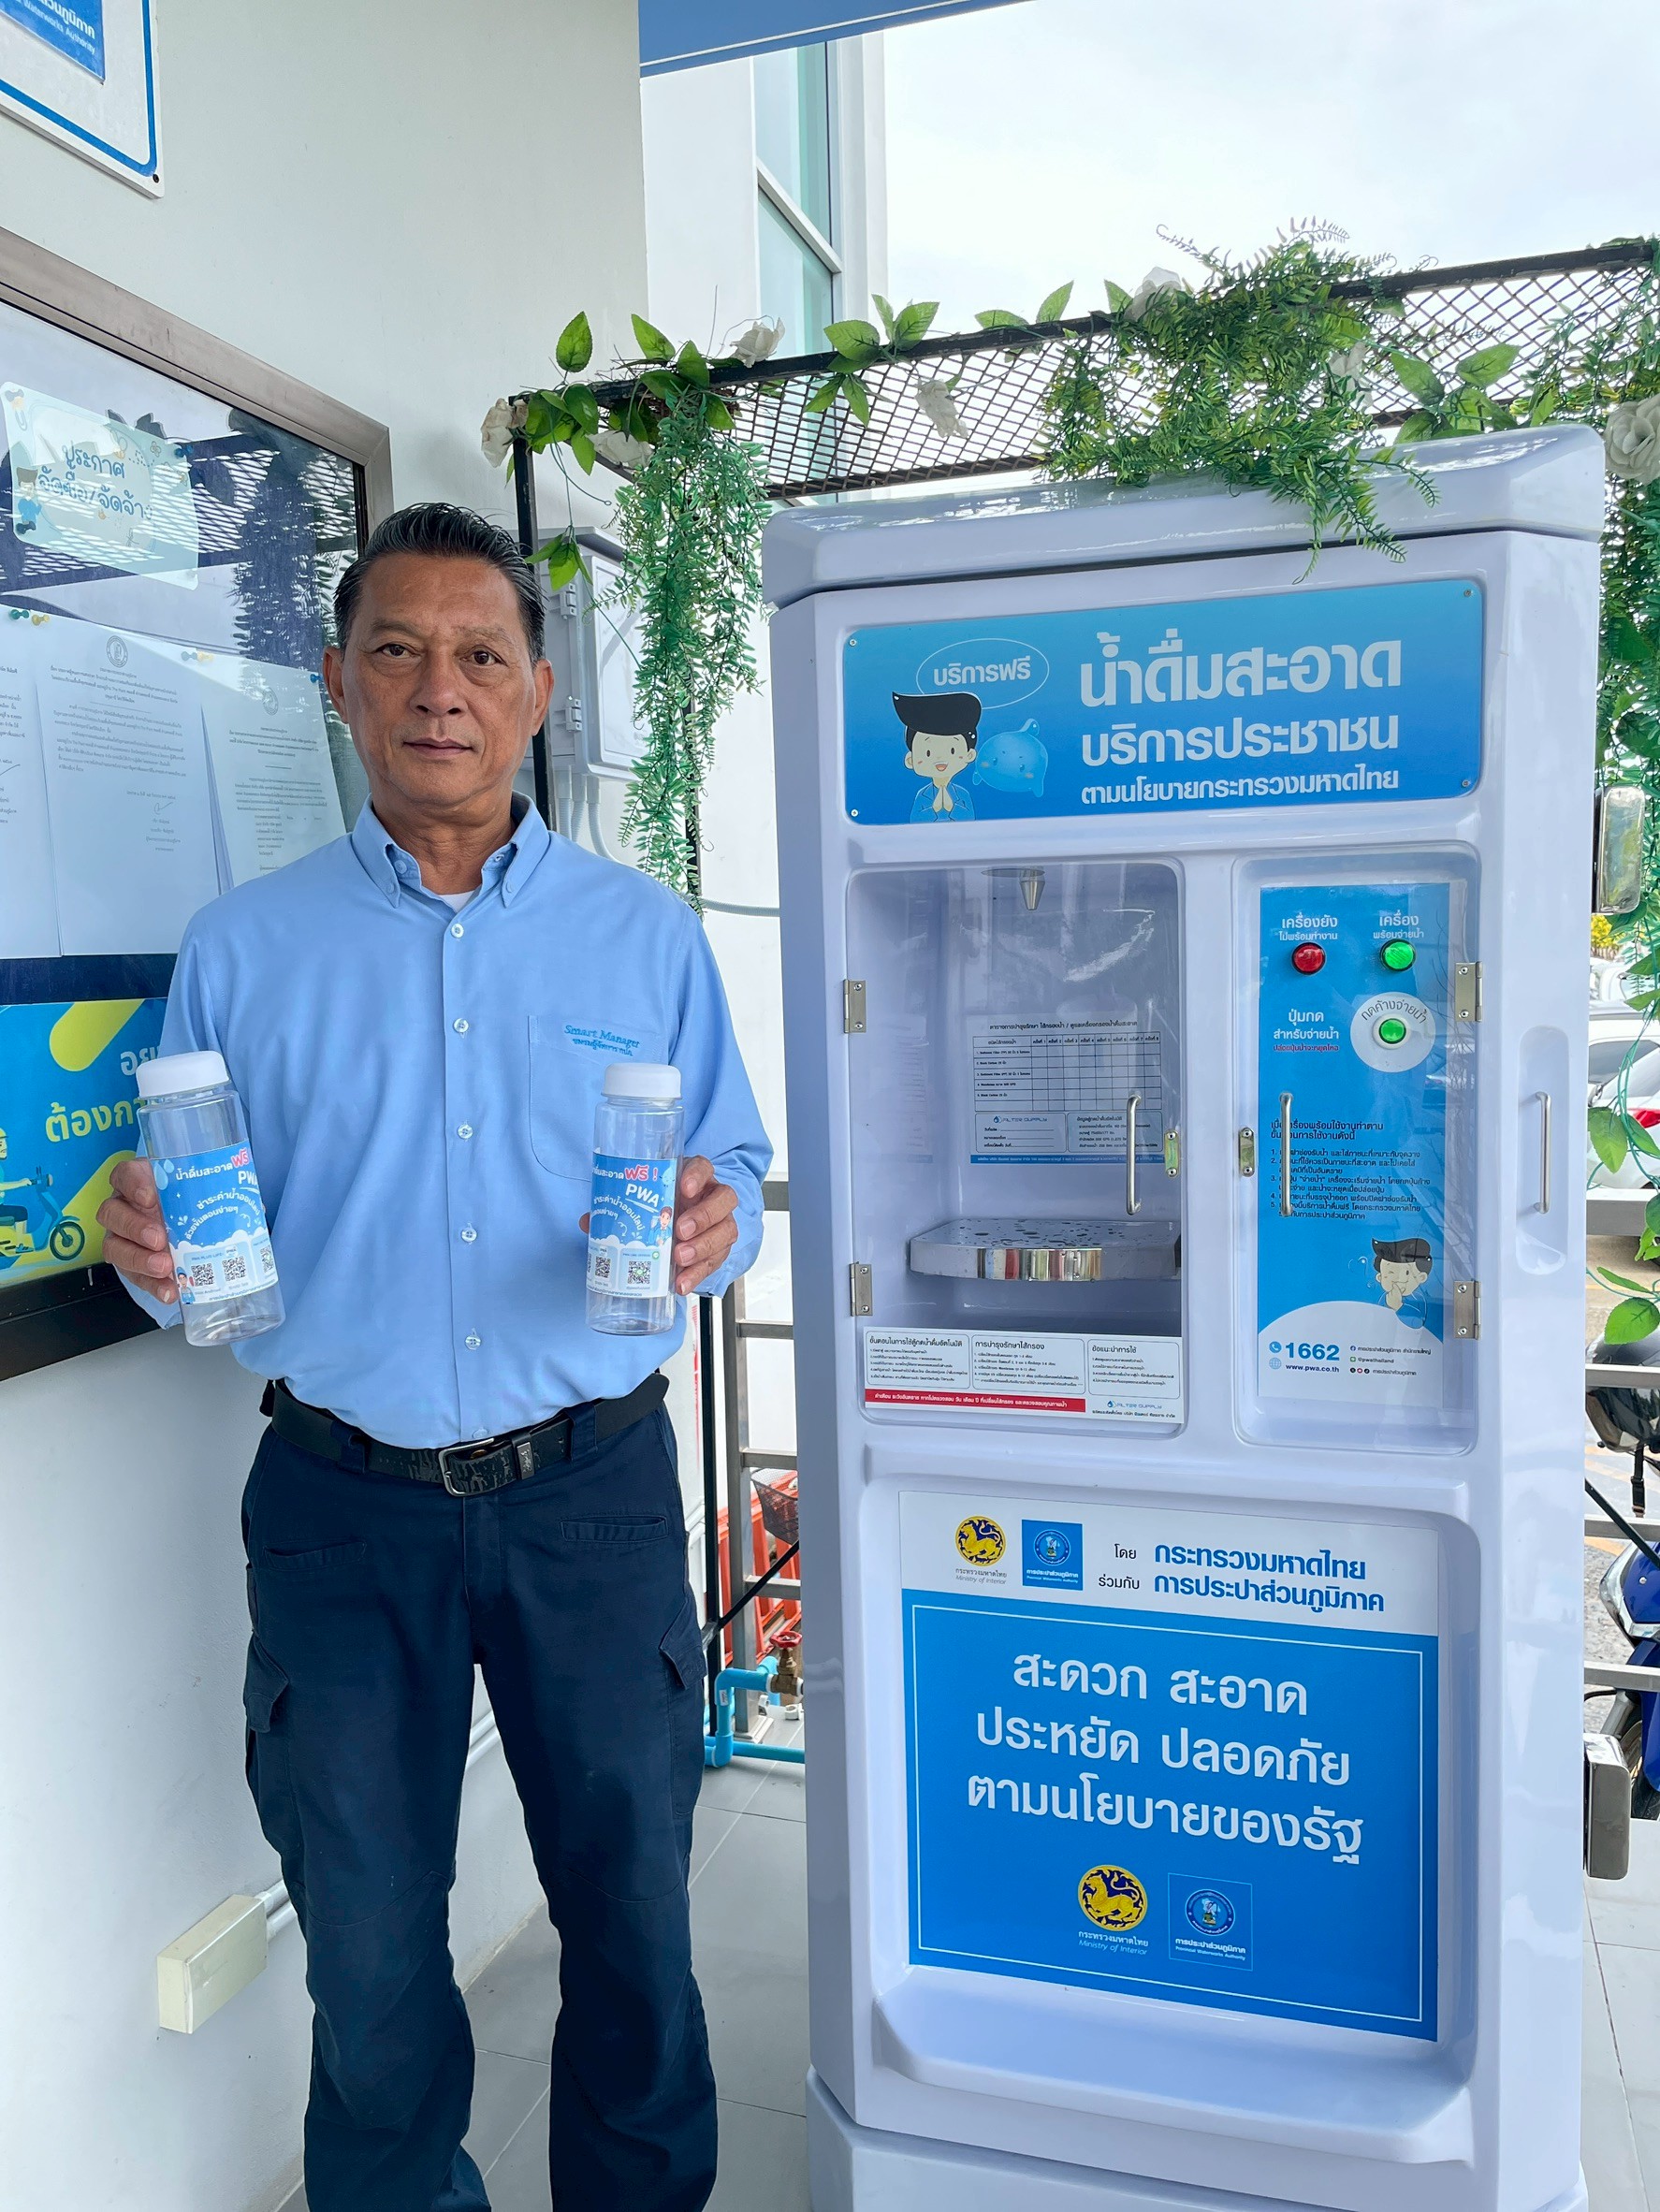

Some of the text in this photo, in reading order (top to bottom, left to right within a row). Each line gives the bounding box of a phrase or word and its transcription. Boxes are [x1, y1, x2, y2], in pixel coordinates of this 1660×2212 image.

[66, 27, 95, 54] Authority
[933, 654, 1032, 689] บริการฟรี
[1079, 627, 1403, 708] น้ำดื่มสะอาด
[1081, 714, 1400, 767] บริการประชาชน
[1081, 763, 1400, 806] ตามนโยบายกระทรวงมหาดไทย
[1281, 911, 1338, 929] เครื่องยัง
[1378, 910, 1419, 926] เครื่อง
[1279, 930, 1338, 941] ไม่พร้อมทำงาน
[1373, 927, 1424, 939] พร้อมจ่ายน้ำ
[1289, 1008, 1324, 1024] ปุ่มกด
[1361, 999, 1427, 1024] กดค้างจ่ายน้ำ
[564, 1025, 640, 1048] Smart Manager
[1273, 1026, 1339, 1040] สำหรับจ่ายน้ำ
[176, 1147, 249, 1181] น้ำดื่มสะอาด ฟรี
[624, 1164, 649, 1182] ฟรี
[625, 1183, 660, 1207] PWA
[975, 1341, 1045, 1350] การบำรุงรักษาไส้กรอง
[1092, 1345, 1137, 1354] ข้อแนะนำการใช้
[1286, 1342, 1340, 1361] 1662
[1286, 1364, 1340, 1373] www.pwa.co.th
[1114, 1544, 1137, 1561] โดย
[1155, 1543, 1366, 1580] กระทรวงมหาดไทย
[955, 1567, 1008, 1578] กระทรวงมหาดไทย
[955, 1575, 977, 1583] Ministry
[1098, 1572, 1141, 1591] ร่วมกับ
[1155, 1574, 1385, 1614] การประปาส่วนภูมิภาค
[1013, 1652, 1307, 1715] สะดวก สะอาด
[977, 1705, 1349, 1786] ประหยัด ปลอดภัย
[968, 1772, 1364, 1865] ตามนโยบายของรัฐ
[1078, 1930, 1149, 1947] กระทรวงมหาดไทย
[1175, 1937, 1246, 1954] การประปาส่วนภูมิภาค
[1078, 1940, 1147, 1956] Ministry of Interior
[1224, 1952, 1246, 1961] Authority
